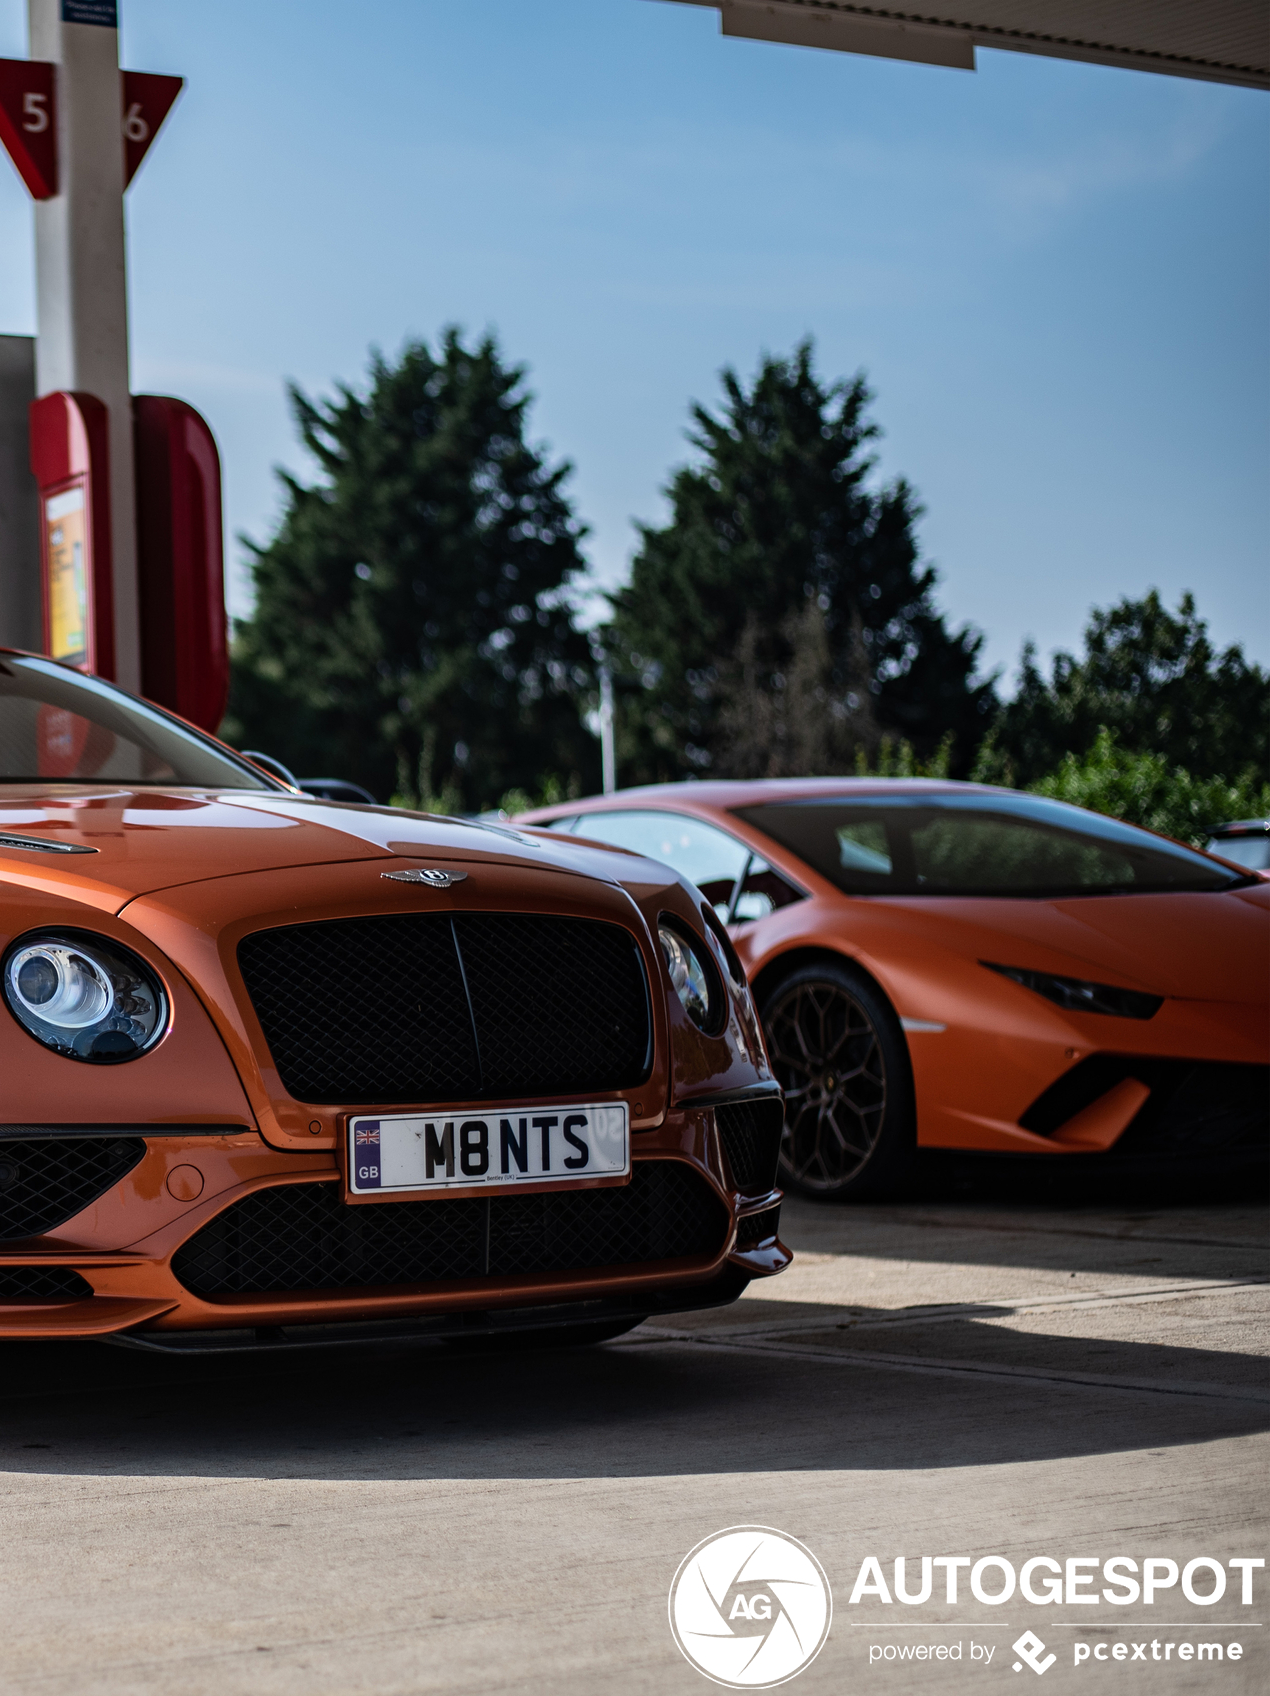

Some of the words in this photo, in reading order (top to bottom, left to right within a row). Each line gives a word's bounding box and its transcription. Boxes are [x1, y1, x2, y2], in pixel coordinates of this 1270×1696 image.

[23, 92, 49, 133] 5
[124, 102, 150, 143] 6
[358, 1165, 379, 1179] GB
